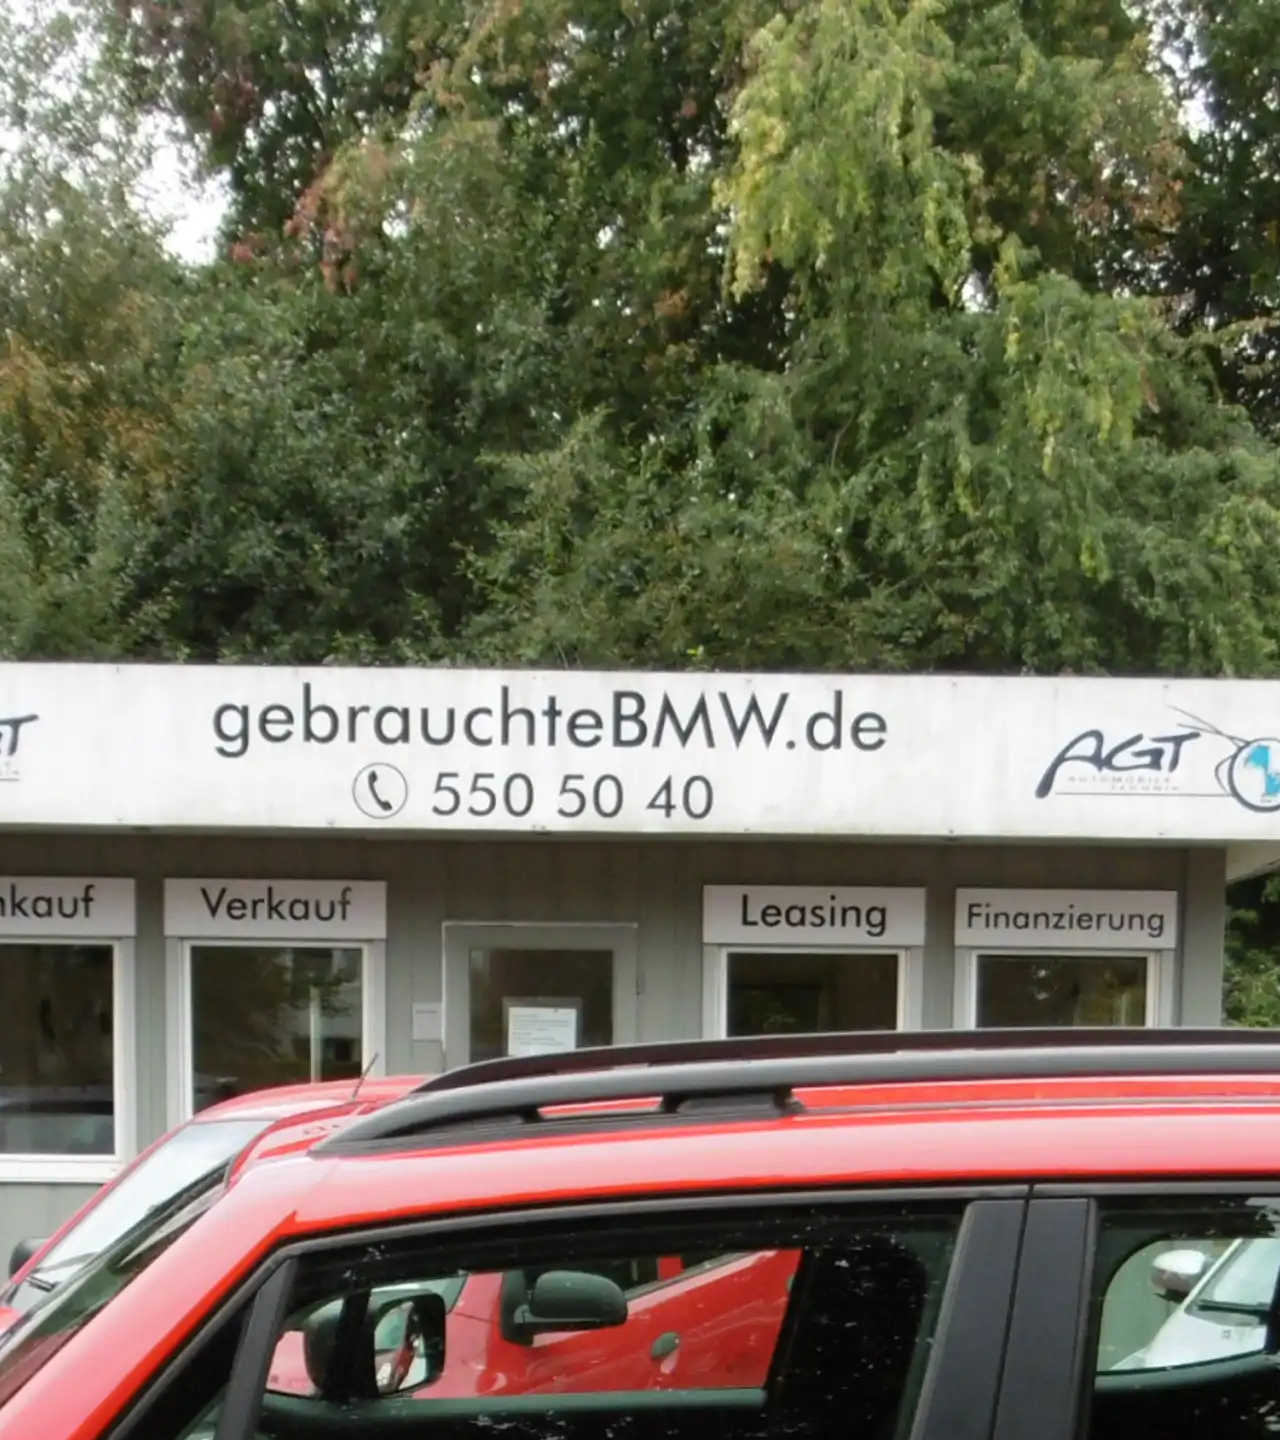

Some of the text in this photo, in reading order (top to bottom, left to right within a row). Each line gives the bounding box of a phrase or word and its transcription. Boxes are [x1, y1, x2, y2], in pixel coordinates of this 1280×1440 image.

[213, 682, 888, 758] gebrauchteBMW.de
[1035, 729, 1202, 799] AGT
[432, 772, 714, 820] 550 50 40
[199, 885, 353, 923] Verkauf
[740, 893, 888, 936] Leasing
[966, 901, 1166, 936] Finanzierung
